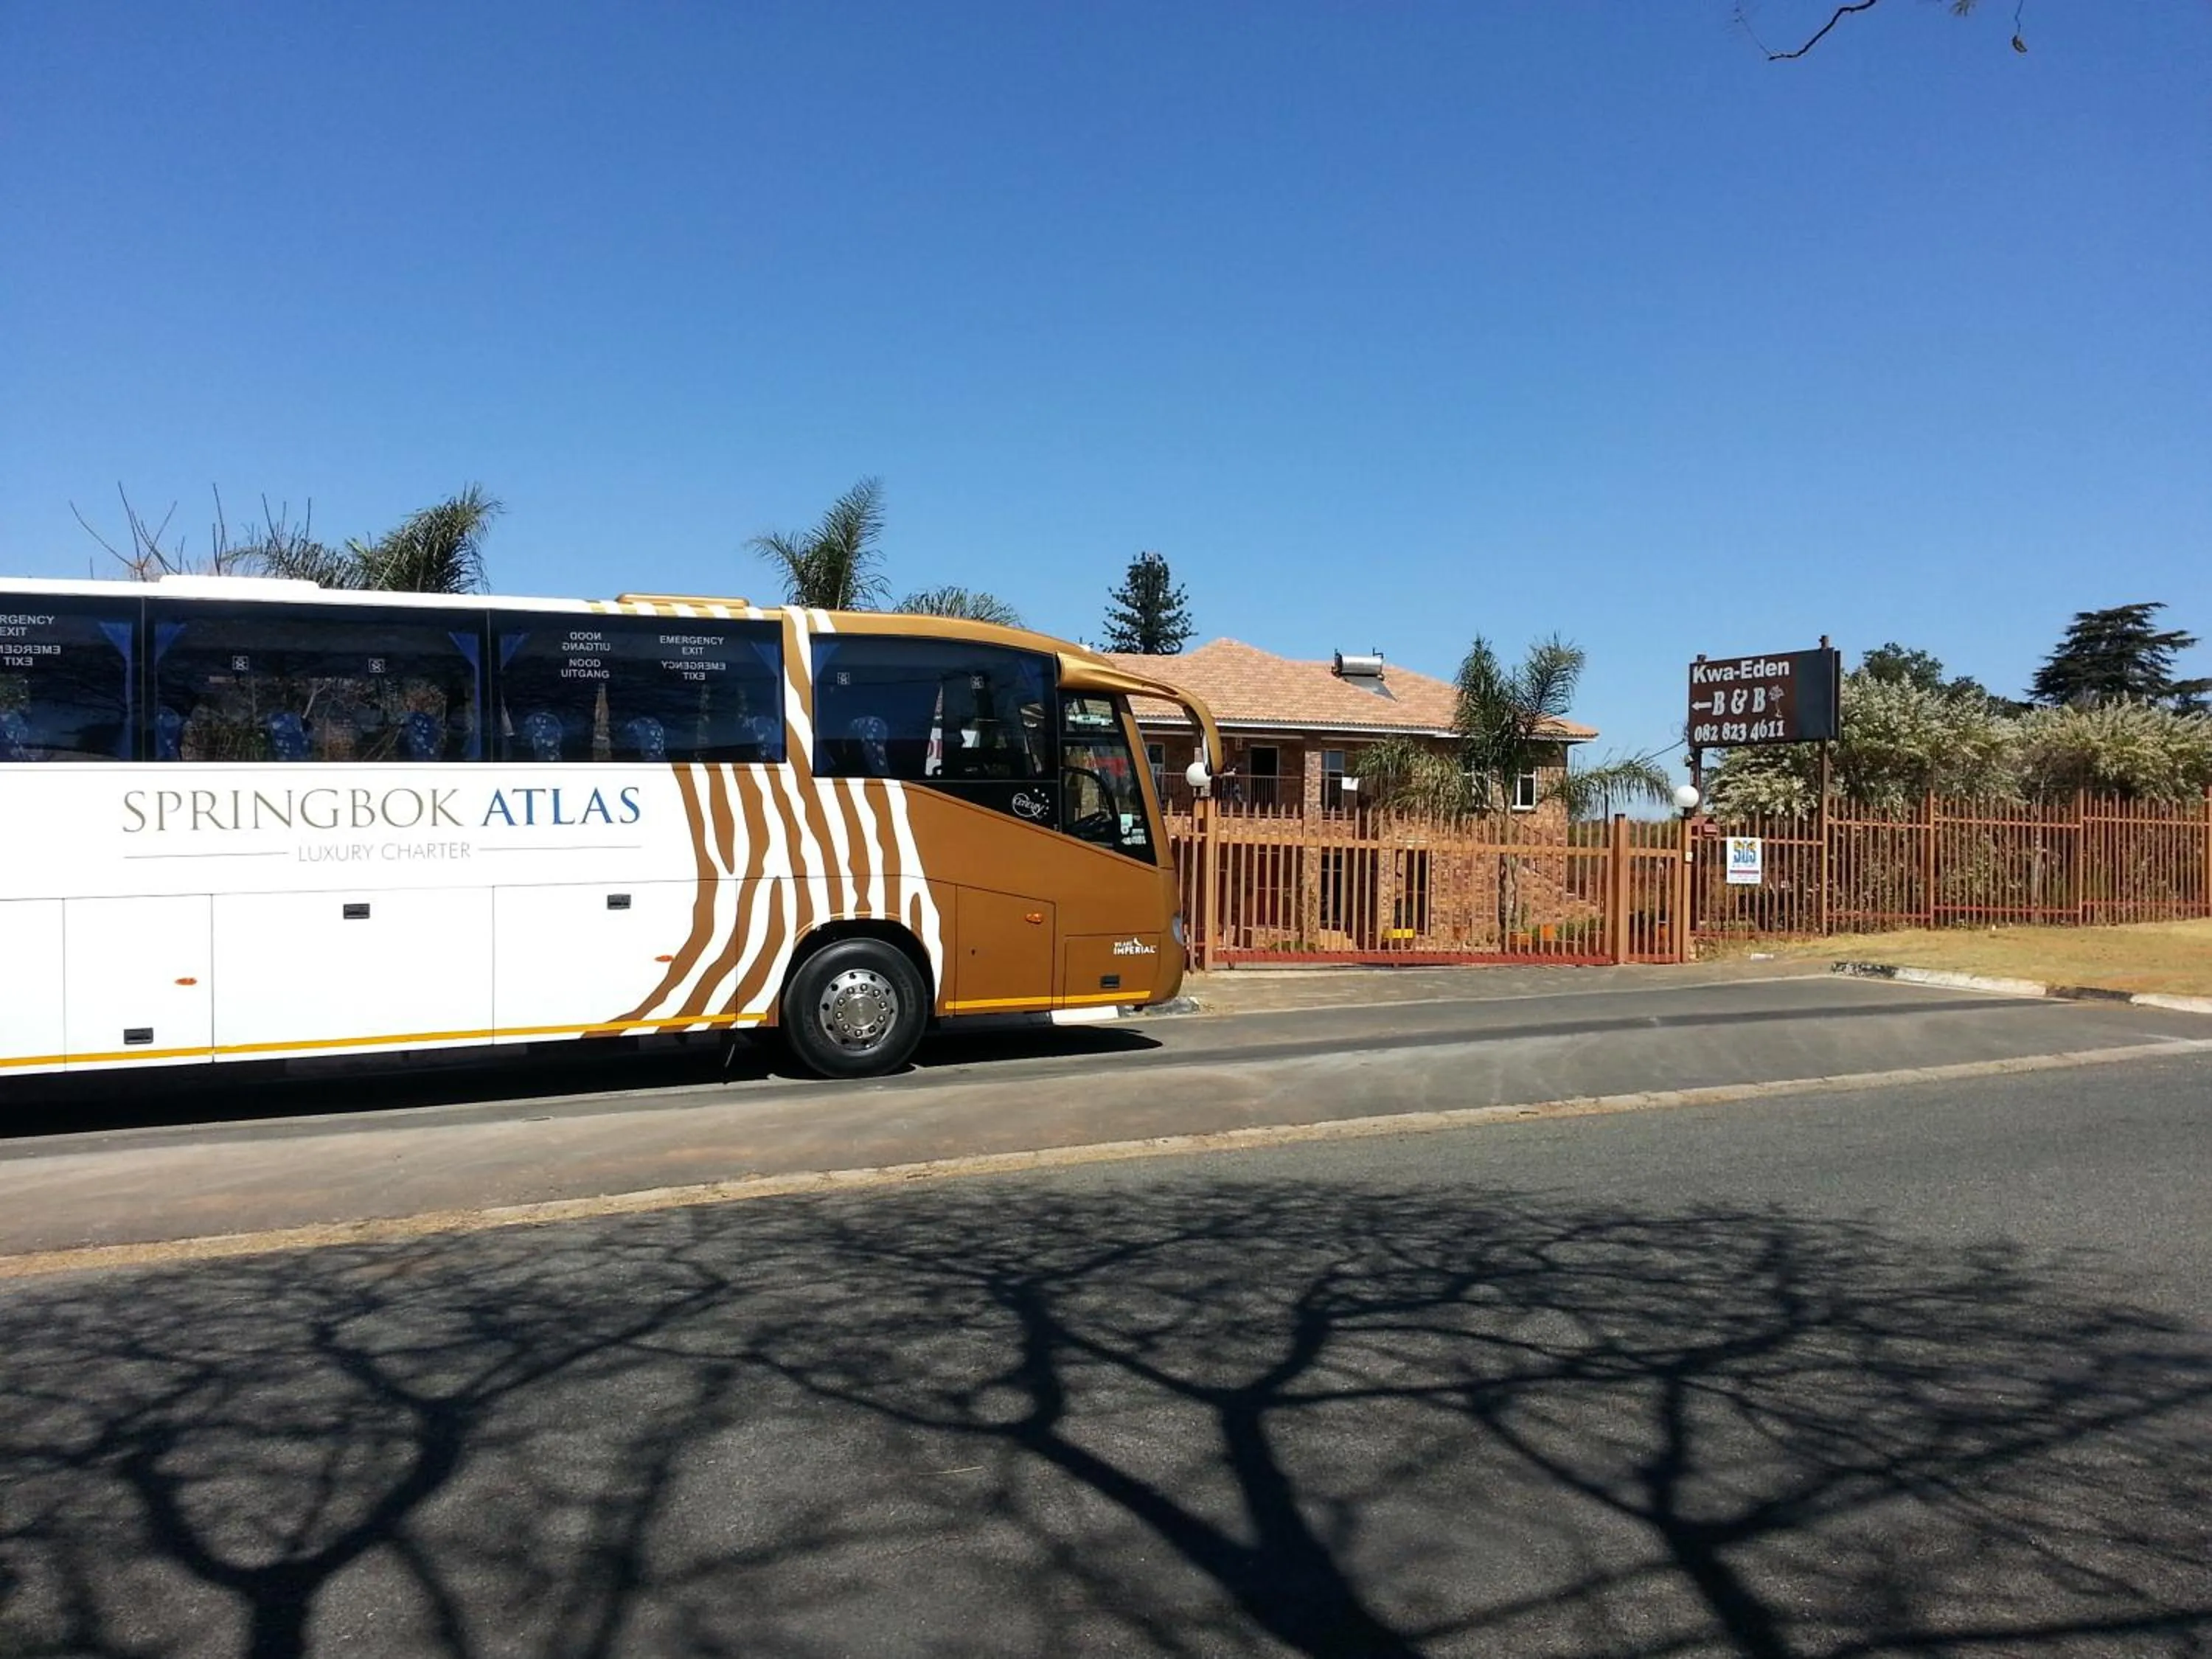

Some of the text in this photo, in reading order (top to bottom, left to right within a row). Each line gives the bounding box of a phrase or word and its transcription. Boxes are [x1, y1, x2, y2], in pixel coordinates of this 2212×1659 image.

[0, 626, 27, 636] EXIT
[660, 635, 724, 645] EMERGENCY
[682, 646, 704, 655] EXIT
[569, 658, 601, 668] NOOD
[561, 669, 610, 678] UITGANG
[1693, 659, 1790, 684] Kwa-Eden
[1711, 687, 1766, 716] B & B
[1694, 719, 1784, 742] 082 823 4611
[122, 787, 641, 832] SPRINGBOK ATLAS
[298, 842, 470, 862] LUXURY CHARTER
[1113, 945, 1156, 955] IMPERIAL
